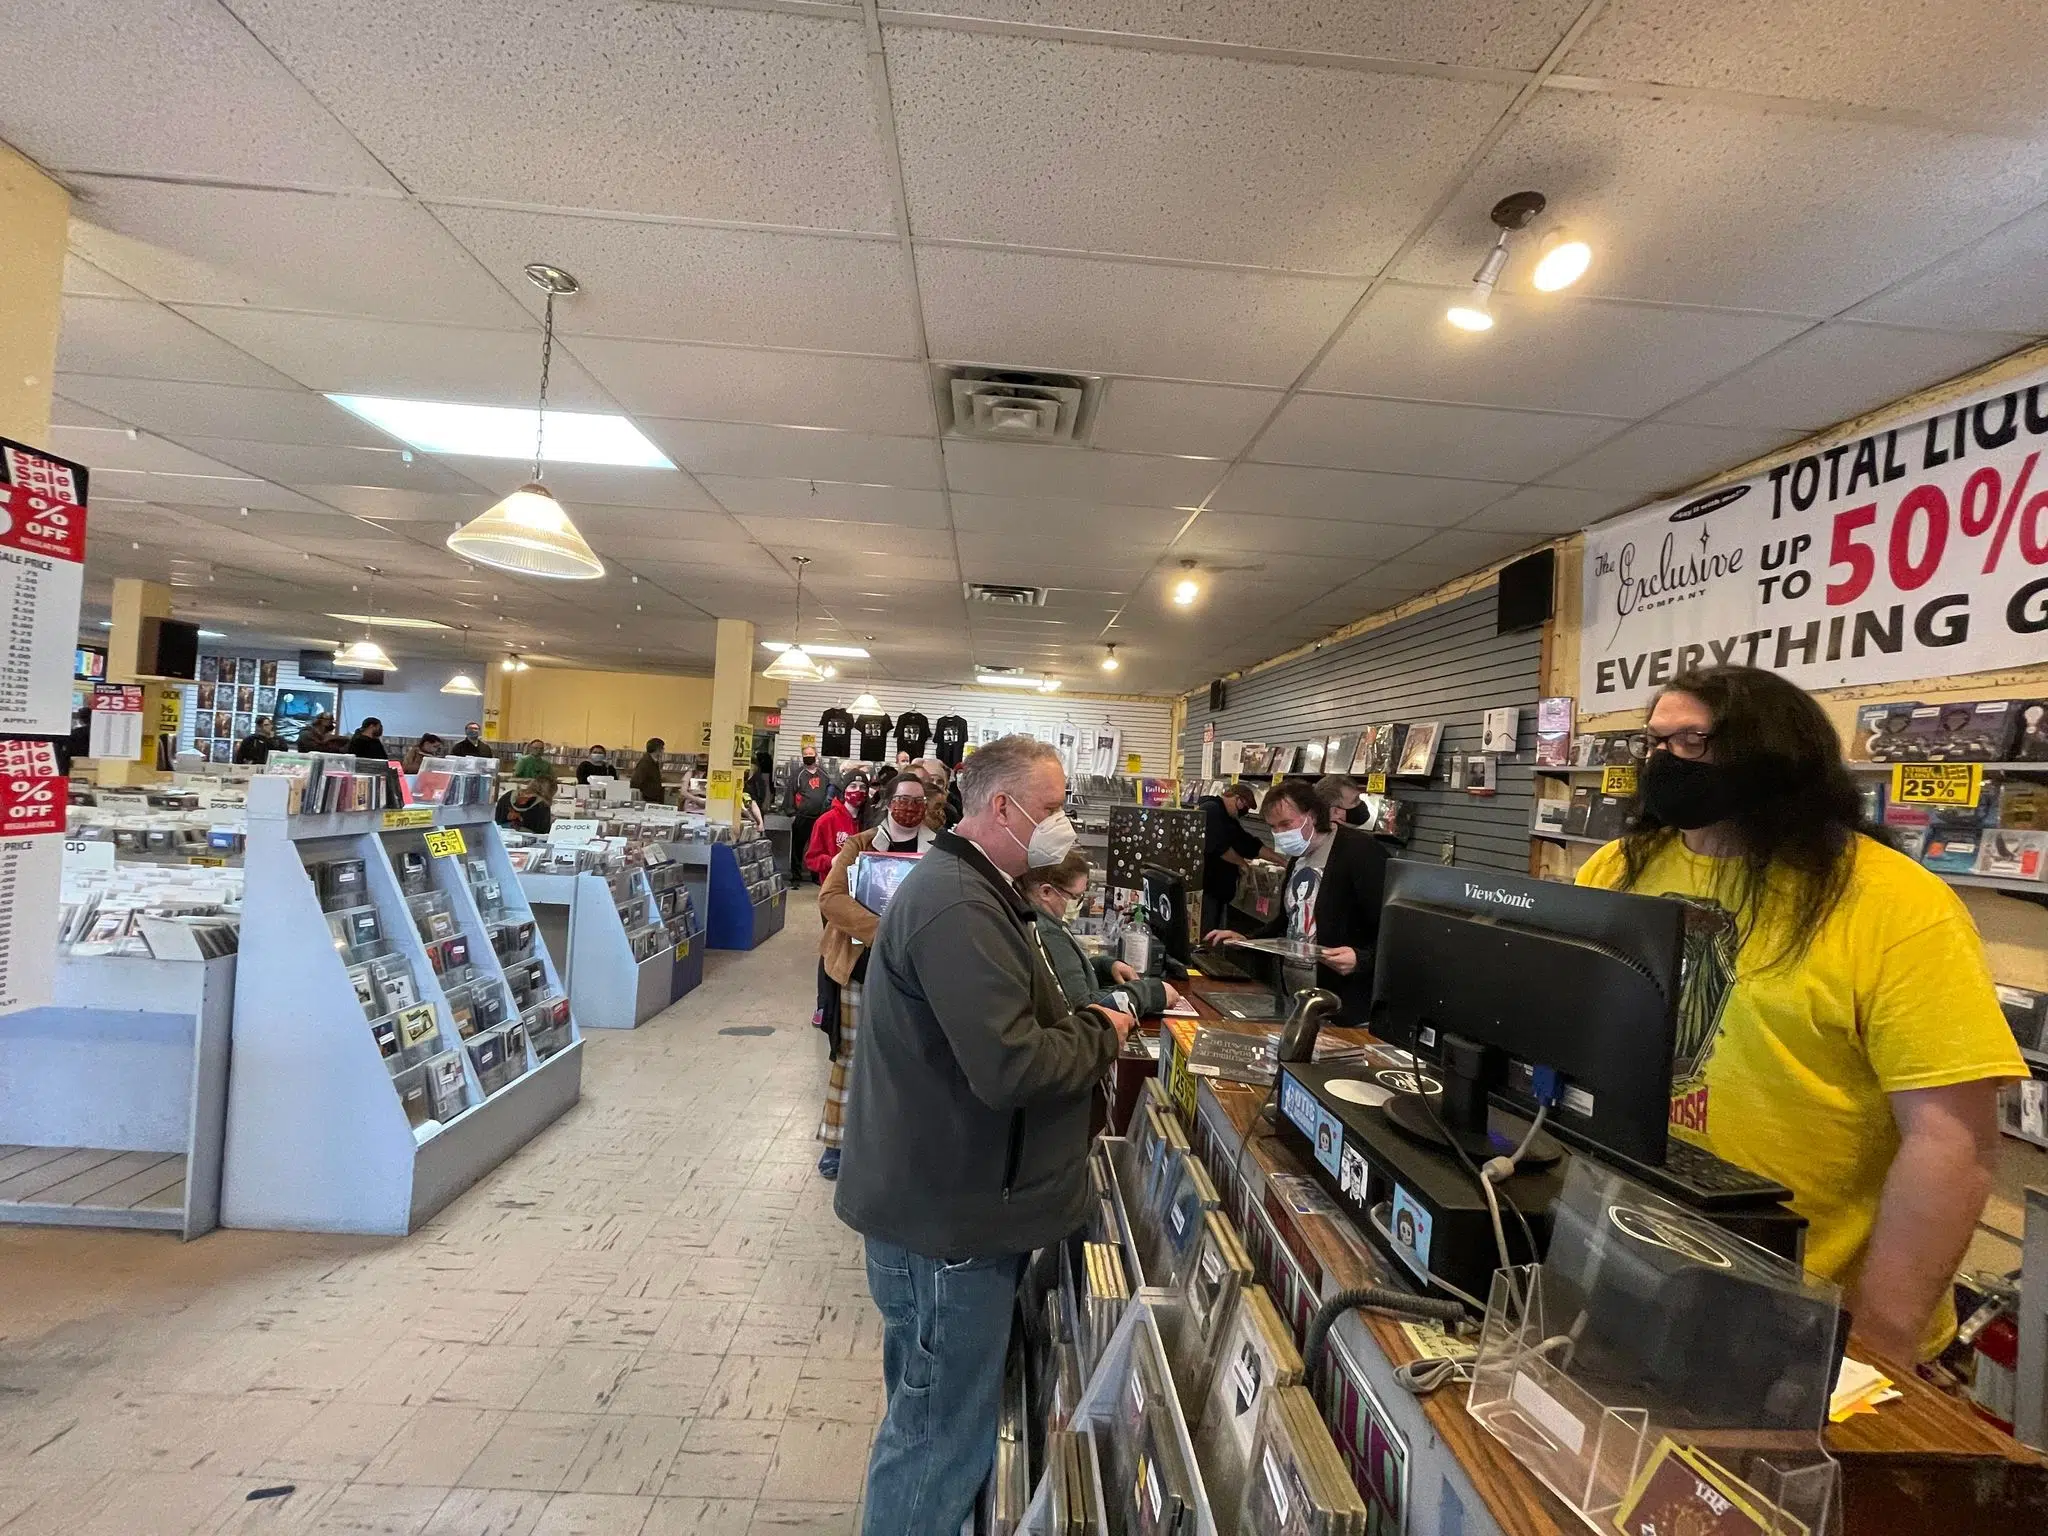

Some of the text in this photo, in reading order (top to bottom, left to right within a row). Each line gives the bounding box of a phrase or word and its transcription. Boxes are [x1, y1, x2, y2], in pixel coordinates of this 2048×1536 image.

[1769, 430, 1906, 521] TOTAL
[25, 521, 69, 541] OFF
[1826, 450, 2048, 606] 50%
[1760, 533, 1812, 571] UP
[24, 557, 53, 571] PRICE
[1594, 531, 1744, 628] The Exclusive
[1758, 569, 1812, 605] TO
[1637, 589, 1707, 612] COMPANY
[1595, 593, 1970, 695] EVERYTHING
[96, 696, 125, 710] 25
[1904, 780, 1955, 798] 25%
[9, 805, 54, 818] OFF
[555, 823, 591, 831] pop-rock
[4, 841, 33, 851] PRICE
[65, 841, 87, 854] ap
[1464, 883, 1536, 909] ViewSonic
[1695, 1480, 1737, 1516] THE
